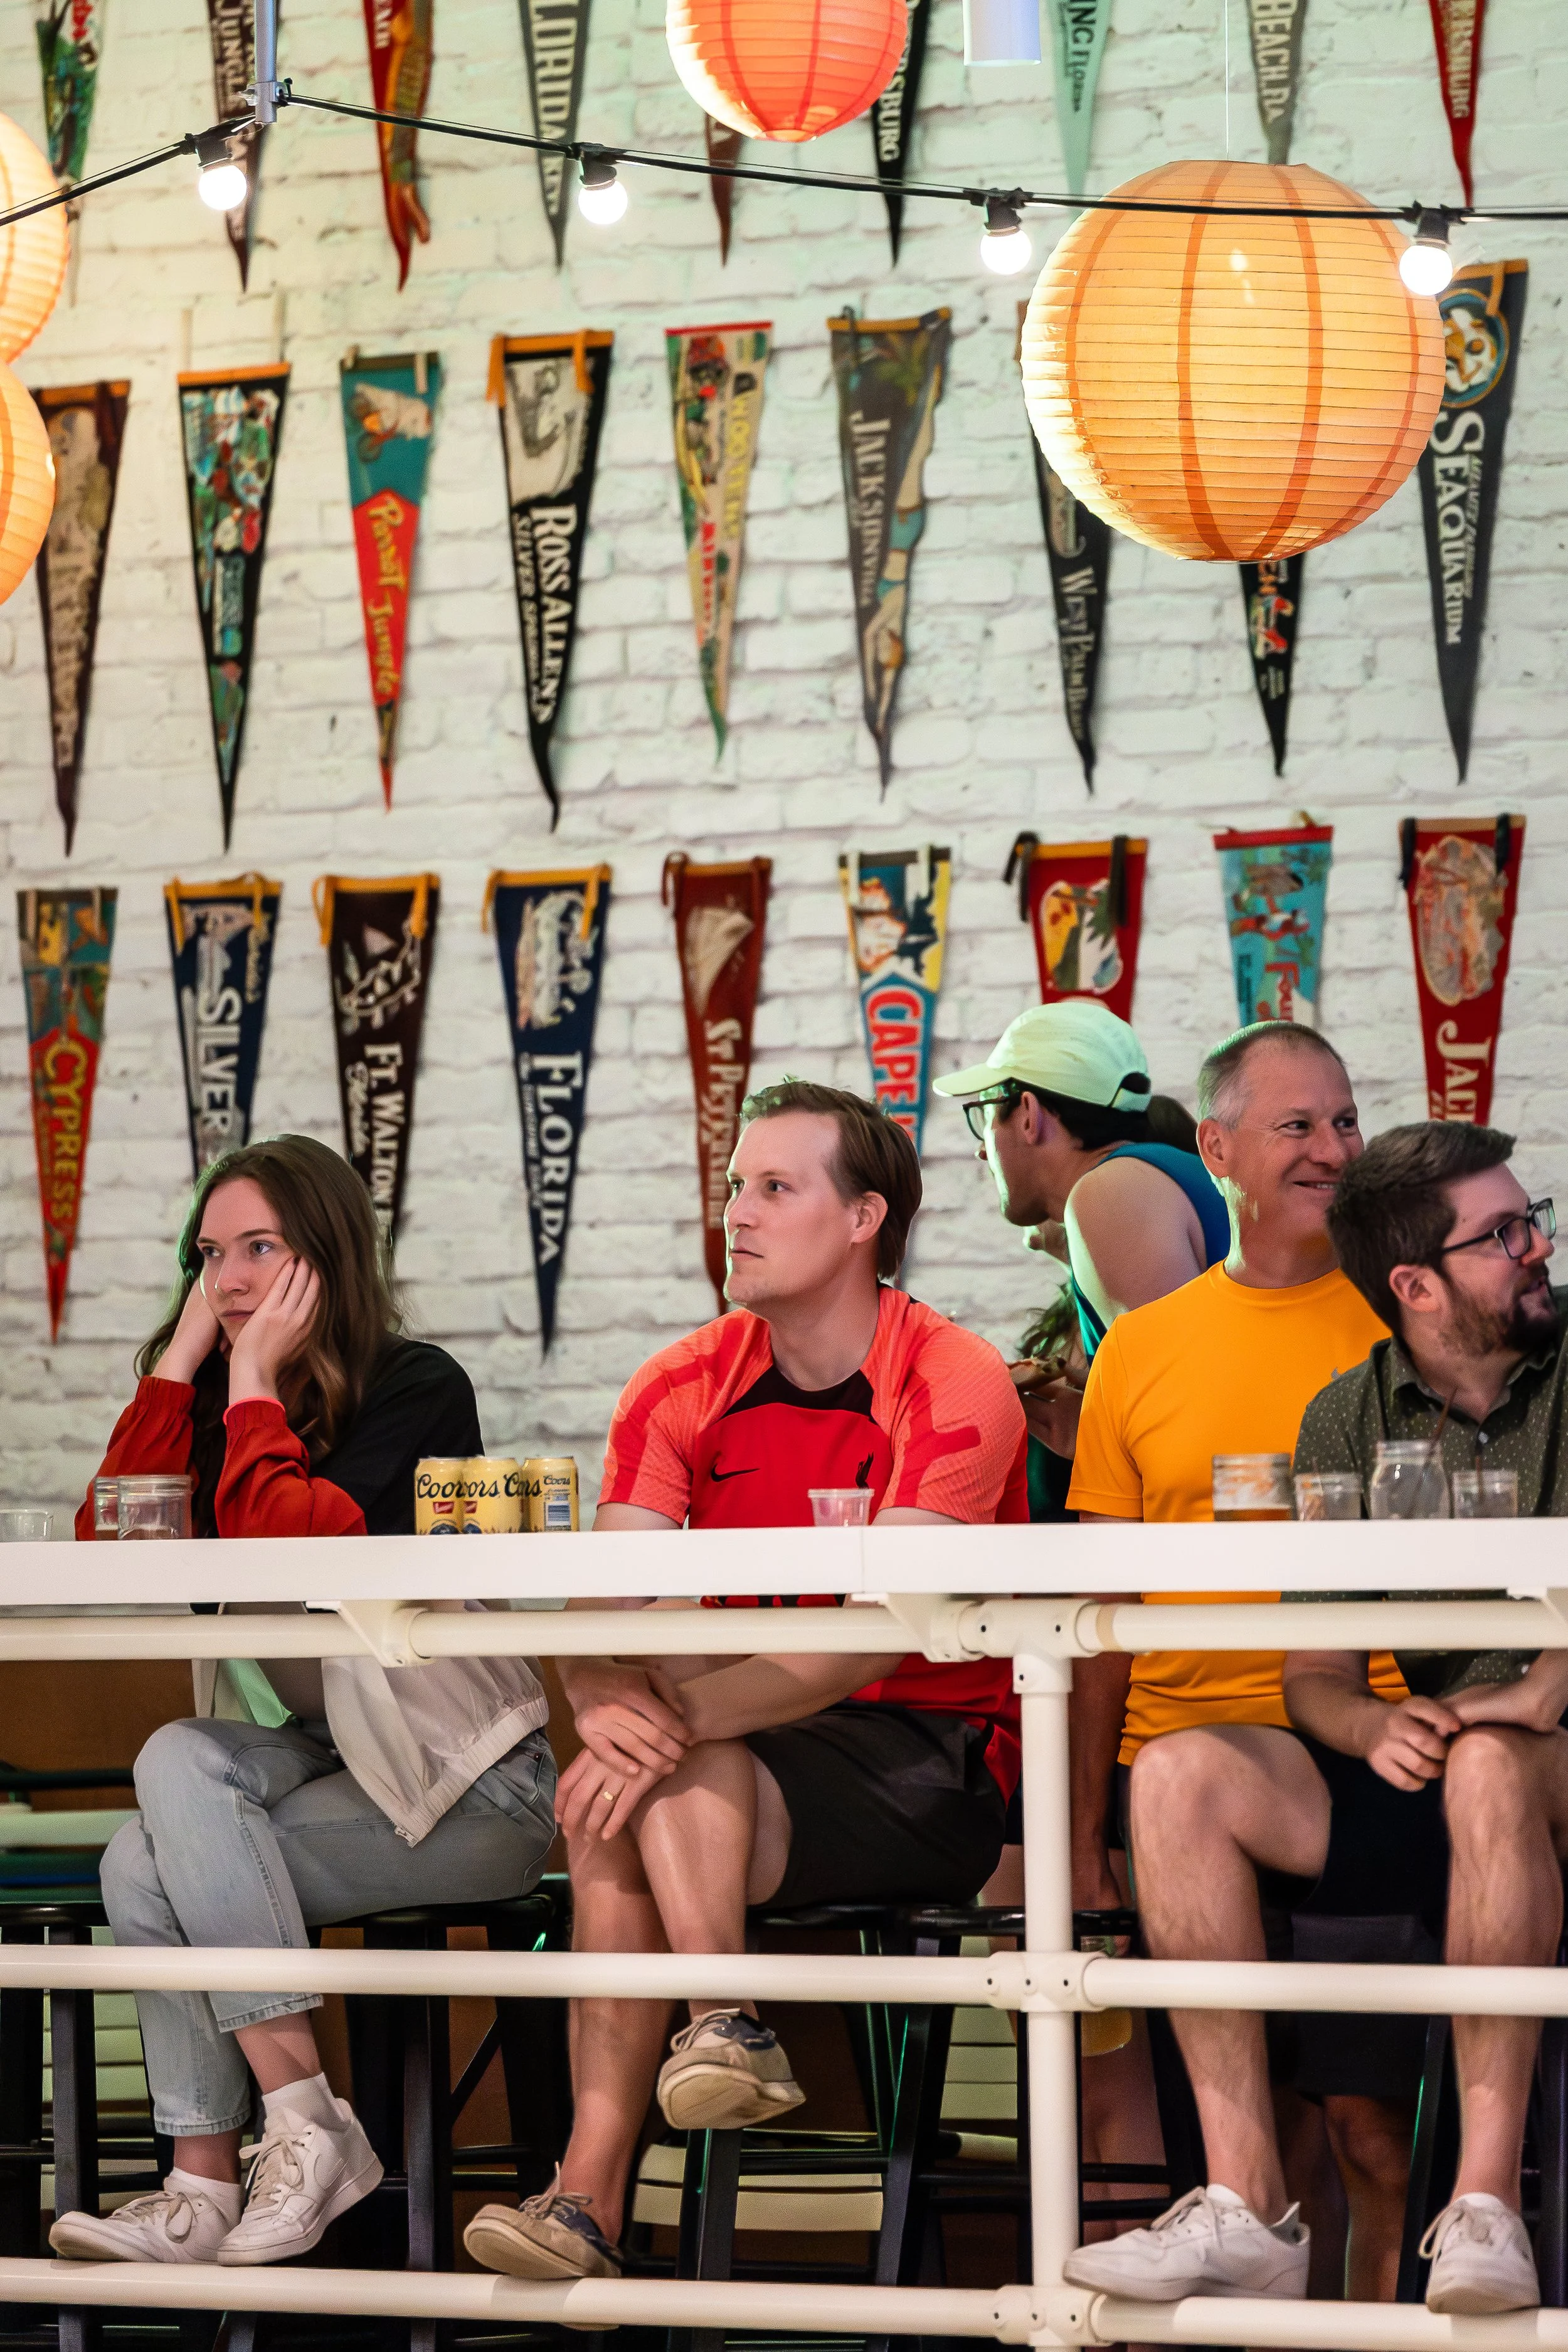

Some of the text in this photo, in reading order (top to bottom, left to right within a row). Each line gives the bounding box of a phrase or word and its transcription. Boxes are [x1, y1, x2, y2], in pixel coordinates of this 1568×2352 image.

[530, 503, 577, 592] ROSS
[1429, 411, 1485, 644] SEAQUARIUM
[198, 986, 243, 1134] SILVER
[866, 986, 923, 1104] CAPE
[45, 1041, 87, 1218] CYPRESS
[531, 1051, 583, 1267] FLORIDA
[543, 1475, 571, 1486] Coors
